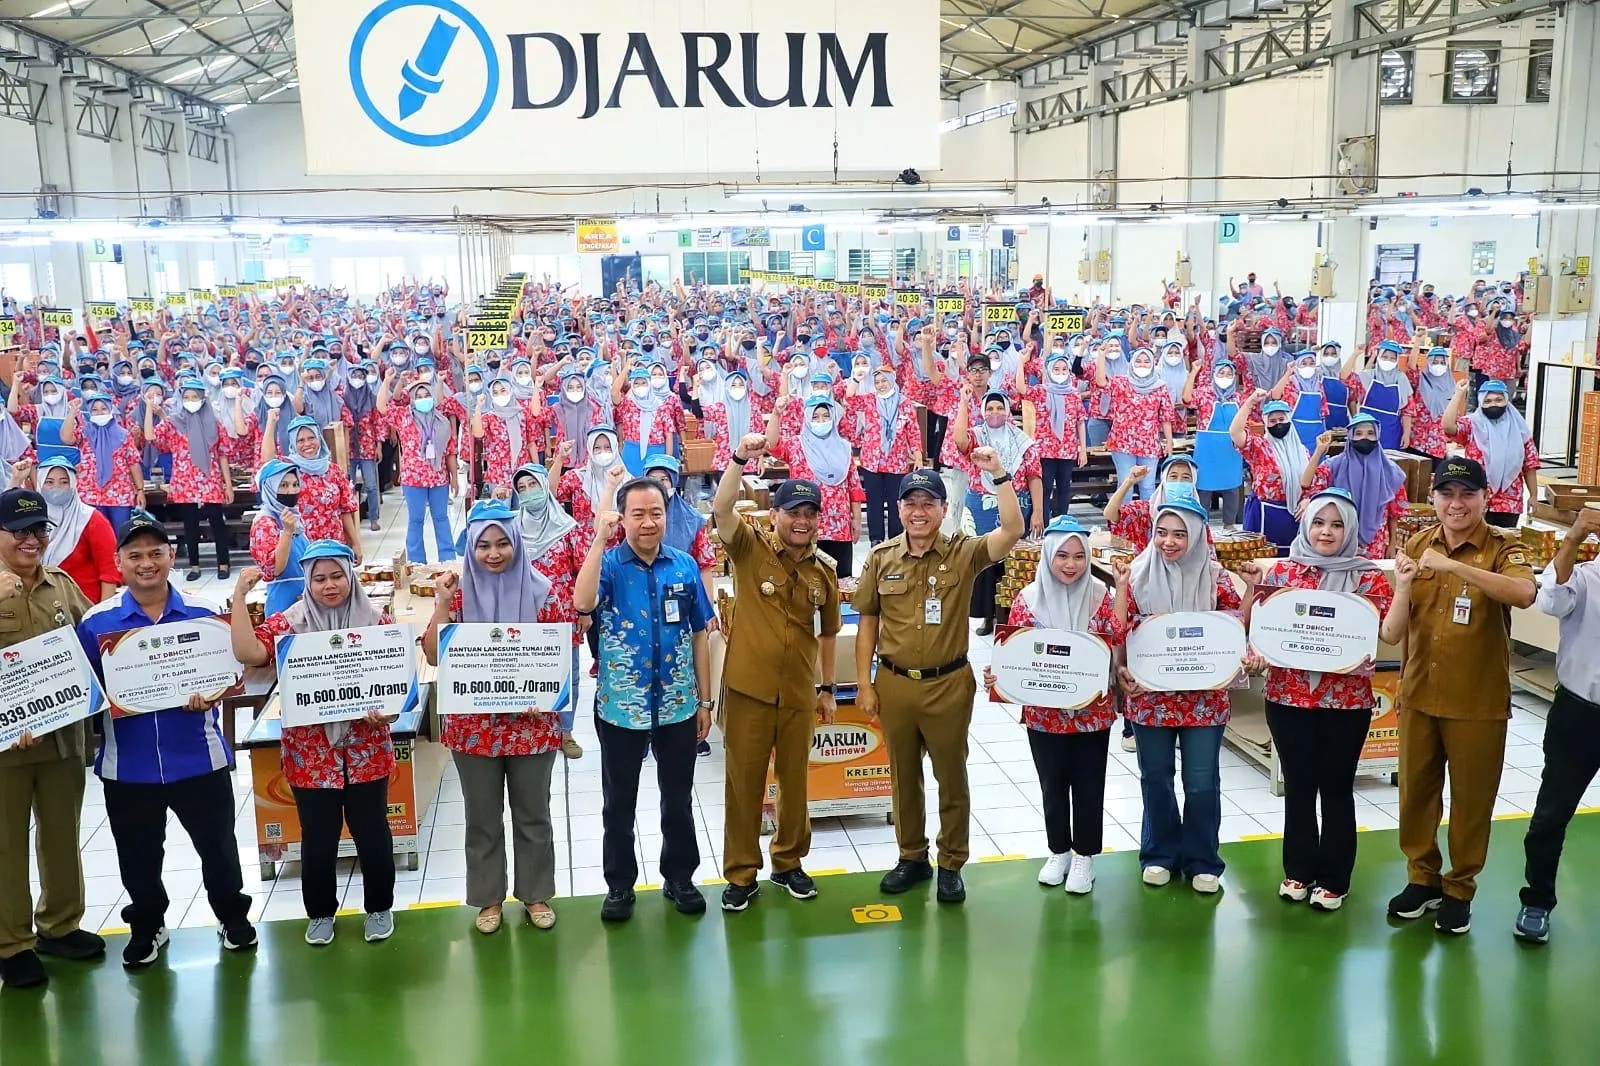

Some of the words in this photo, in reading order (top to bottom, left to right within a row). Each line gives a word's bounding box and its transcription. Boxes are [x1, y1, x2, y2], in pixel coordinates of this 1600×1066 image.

[507, 32, 894, 119] DJARUM
[950, 227, 958, 238] G
[1224, 222, 1236, 237] D
[807, 228, 820, 244] C
[96, 239, 105, 254] B
[898, 295, 908, 303] 40
[910, 295, 920, 303] 39
[144, 302, 154, 310] 55
[938, 300, 948, 310] 37
[952, 300, 962, 310] 38
[92, 307, 102, 316] 45
[104, 308, 115, 316] 46
[988, 308, 1000, 319] 28
[1002, 308, 1014, 318] 27
[46, 315, 57, 324] 44
[60, 315, 72, 324] 43
[1051, 318, 1064, 330] 25
[1067, 318, 1080, 330] 26
[0, 322, 14, 332] 34
[472, 334, 486, 346] 23
[490, 334, 504, 345] 24
[164, 648, 192, 658] DBHCHT
[288, 655, 322, 664] BANTUAN
[324, 652, 362, 660] LANGSUNG
[374, 653, 404, 661] TEMBAKAU
[0, 667, 26, 680] GSUNG
[28, 658, 50, 670] TUNAI
[52, 650, 72, 662] (BLT)
[2, 675, 22, 686] CUKAI
[23, 669, 40, 678] HASIL
[41, 656, 72, 670] TEMBAKAU
[172, 668, 196, 678] DJARUM
[292, 672, 330, 680] PEMERINTAH
[332, 668, 360, 677] PROVINSI
[30, 678, 50, 688] JAWA
[50, 667, 76, 680] TENGAH
[453, 680, 560, 696] Rp.600.000,-/Orang
[296, 682, 408, 706] Rp.600.000,-/Orang
[318, 707, 360, 716] KABUPATEN
[46, 712, 70, 724] KUDUS
[1368, 730, 1398, 738] RETE
[820, 747, 866, 756] Istimewa
[846, 768, 890, 776] KRETEK
